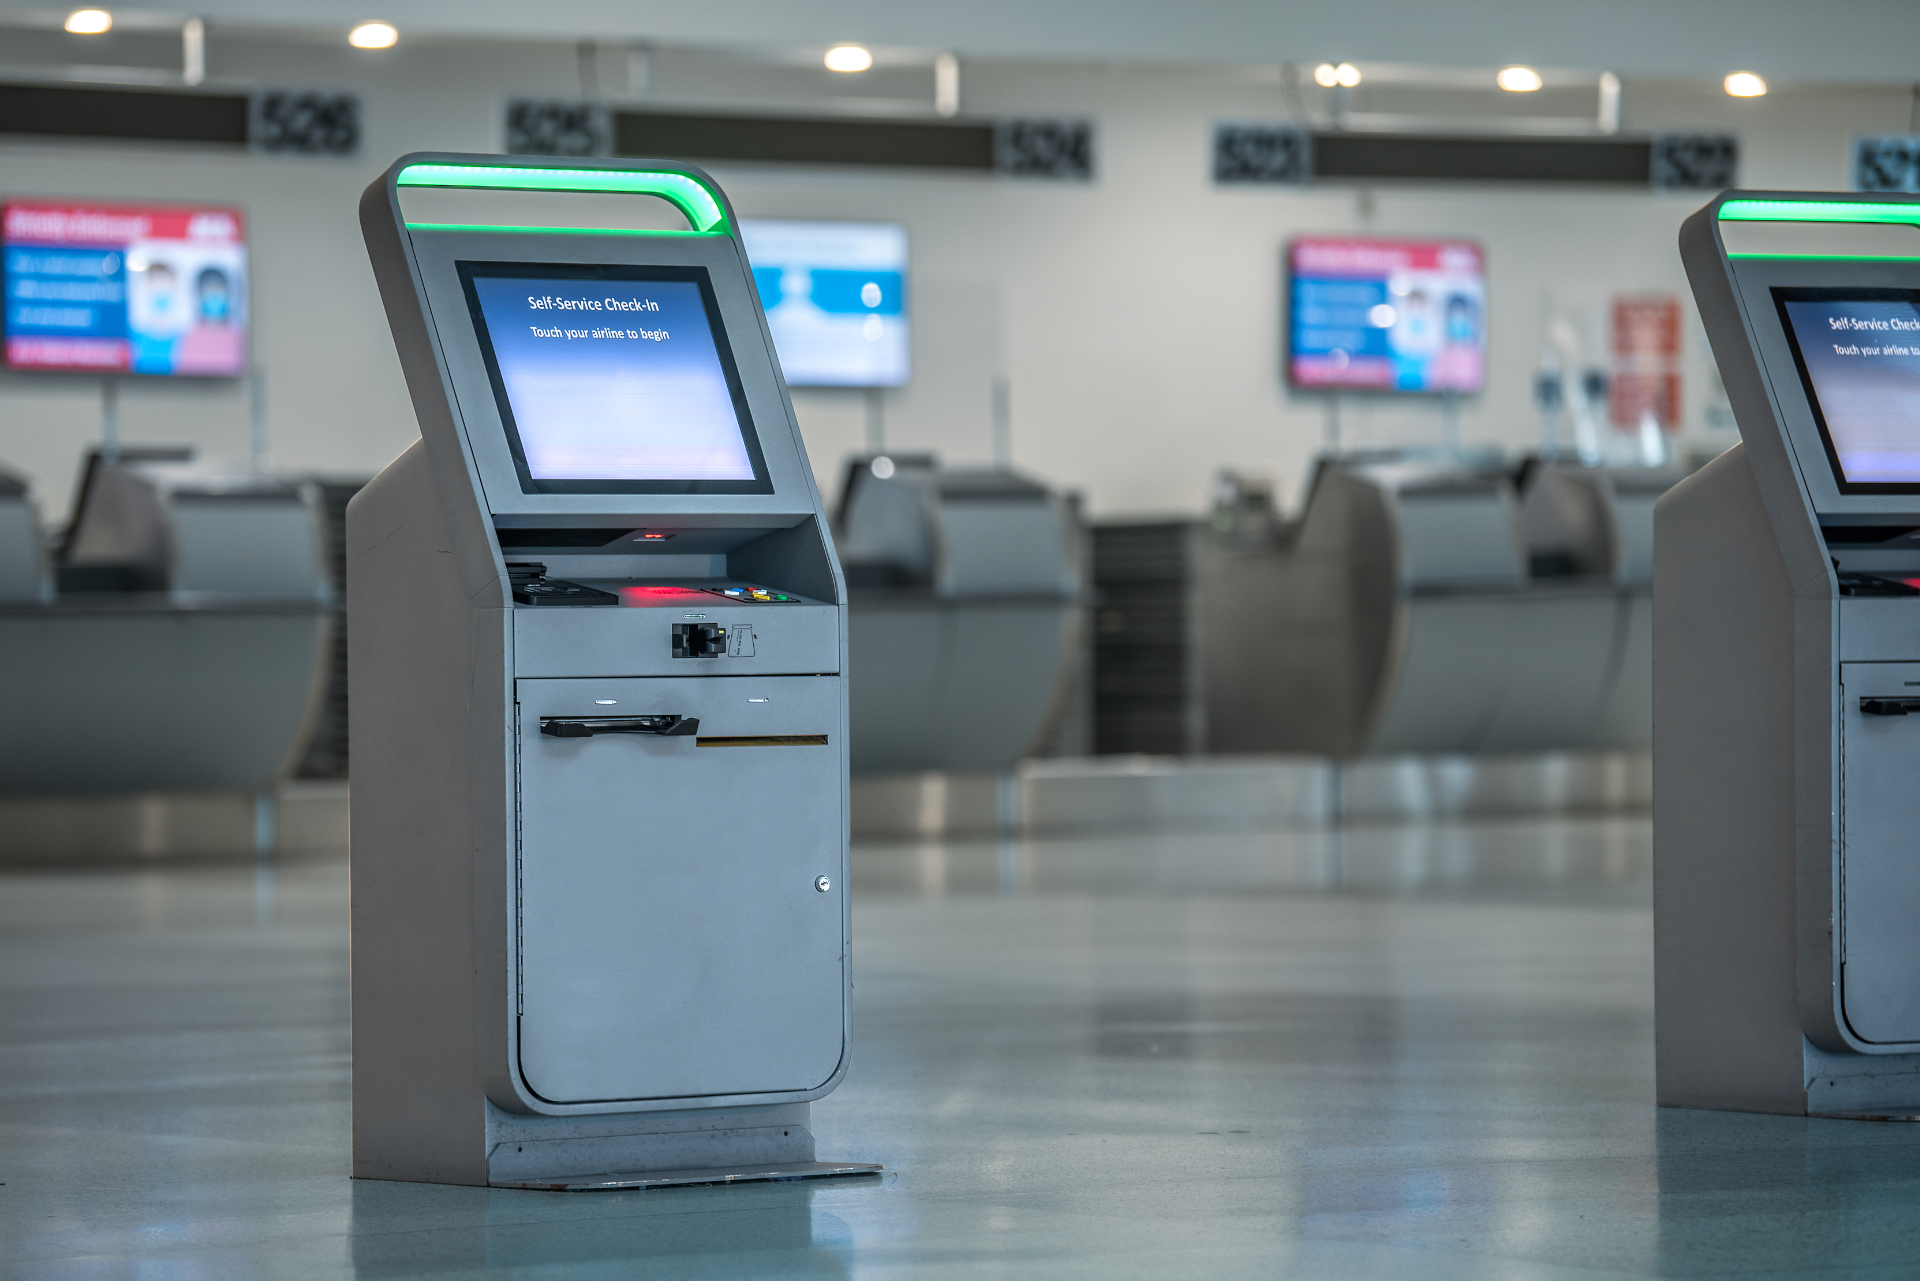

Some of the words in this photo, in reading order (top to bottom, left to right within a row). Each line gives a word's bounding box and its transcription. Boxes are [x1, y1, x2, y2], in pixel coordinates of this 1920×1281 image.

[261, 90, 361, 154] 526
[508, 101, 598, 157] 525
[528, 296, 602, 311] Self-Service
[604, 298, 660, 312] Check-In
[1829, 317, 1889, 331] Self-Service
[530, 326, 563, 338] Touch
[564, 329, 589, 340] your
[591, 328, 625, 339] airline
[626, 329, 639, 339] to
[640, 328, 670, 342] begin
[1833, 344, 1860, 355] Touch
[1861, 346, 1880, 357] your
[1882, 344, 1910, 356] airline
[1910, 346, 1920, 356] to
